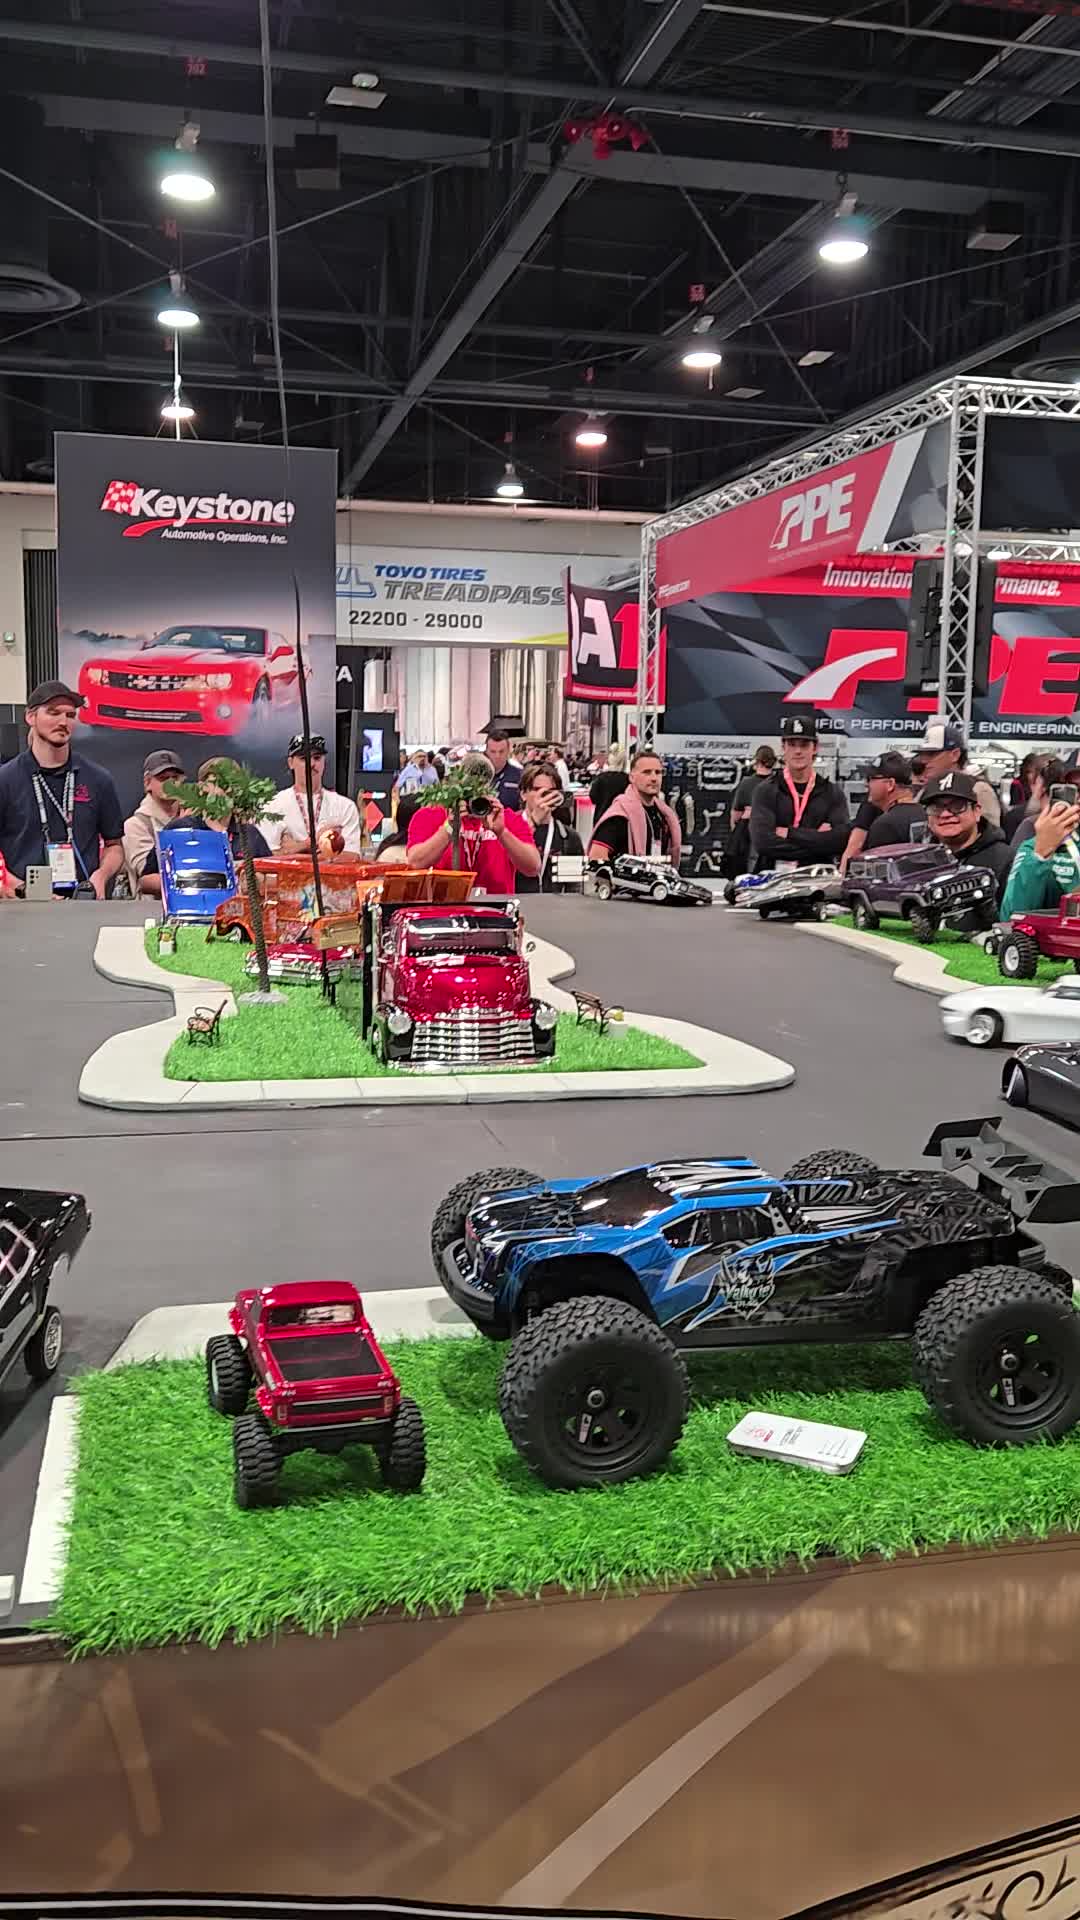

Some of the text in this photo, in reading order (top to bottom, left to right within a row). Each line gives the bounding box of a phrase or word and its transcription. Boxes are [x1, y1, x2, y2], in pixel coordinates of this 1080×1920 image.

[130, 488, 295, 527] Keystone
[769, 473, 856, 550] PPE
[161, 528, 215, 541] Automotive
[216, 531, 269, 544] Operations,
[374, 564, 488, 581] TOYO TIRES
[383, 581, 567, 606] TREADPASS
[349, 610, 407, 626] 22200
[425, 613, 483, 629] 29000
